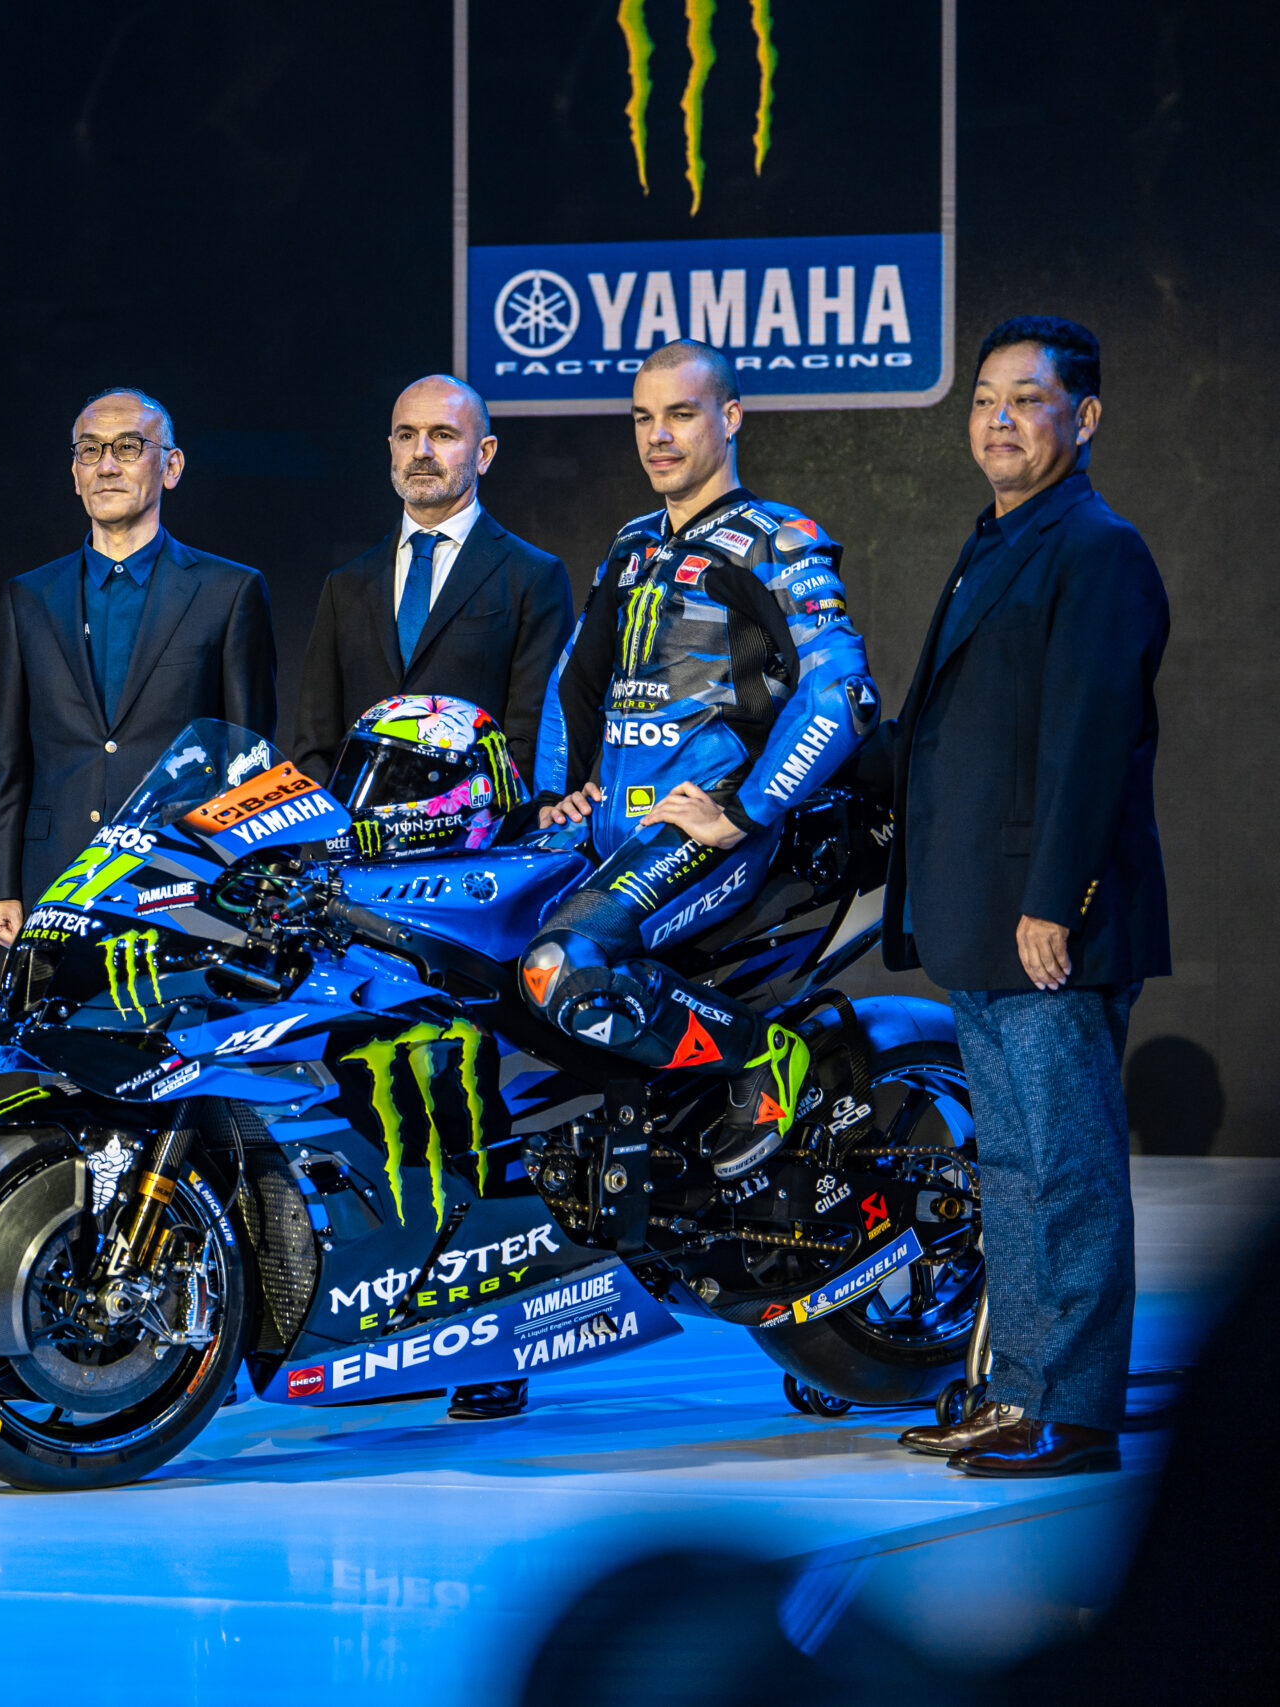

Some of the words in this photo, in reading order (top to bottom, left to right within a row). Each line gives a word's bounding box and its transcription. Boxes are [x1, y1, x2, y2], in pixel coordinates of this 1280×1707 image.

[588, 265, 911, 350] YAMAHA
[495, 359, 644, 376] FACTO
[736, 352, 912, 371] RACING
[685, 502, 749, 540] DAINESE
[722, 530, 750, 548] YAMAHA
[781, 556, 833, 580] DAINESE
[612, 679, 670, 700] MONSTER
[606, 721, 680, 747] ENEOS
[764, 715, 839, 801] YAMAHA
[238, 779, 313, 812] Beta
[231, 793, 334, 844] YAMAHA
[385, 813, 464, 835] MONSTER
[91, 825, 158, 854] ENEOS
[399, 829, 454, 843] ENERGY
[34, 844, 152, 910] 21
[666, 847, 714, 884] ENERGY
[137, 881, 195, 905] YAMALUBE
[650, 861, 747, 949] DAINESE
[21, 929, 71, 942] ENERGY
[23, 907, 91, 936] MONSTER
[670, 988, 734, 1026] DAINESE
[827, 1103, 872, 1136] RCB
[814, 1182, 852, 1214] GILLES
[834, 1243, 908, 1301] MICHELIN
[522, 1271, 614, 1321] YAMALUBE
[528, 1326, 549, 1339] Liquid
[550, 1319, 572, 1331] Engine
[332, 1313, 499, 1390] ENEOS
[290, 1375, 322, 1388] ENEOS
